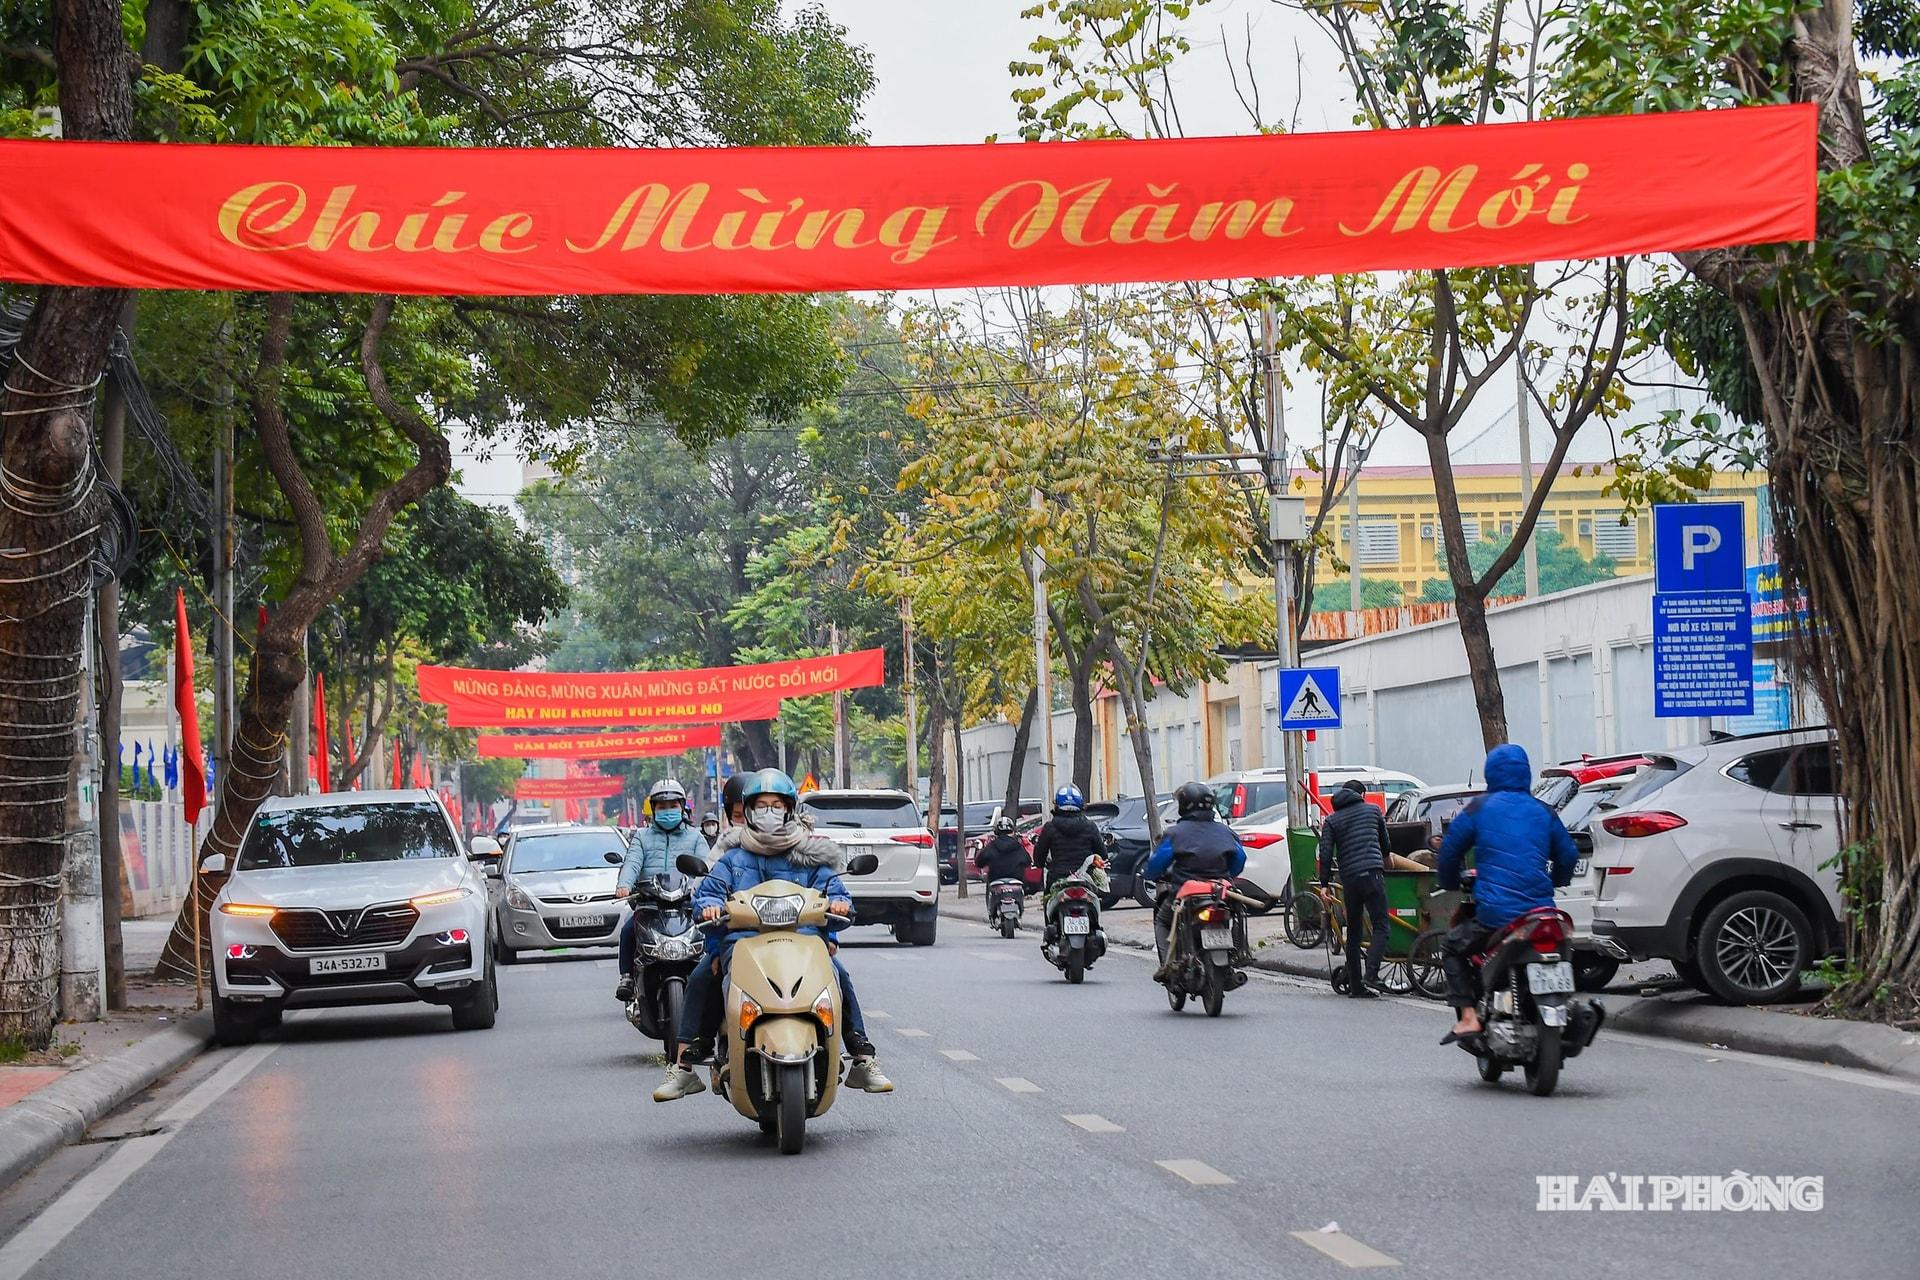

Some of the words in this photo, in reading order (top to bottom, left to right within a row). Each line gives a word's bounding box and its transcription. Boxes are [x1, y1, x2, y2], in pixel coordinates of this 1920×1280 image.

[217, 181, 538, 253] Chúc
[565, 182, 958, 264] Mừng
[976, 178, 1298, 249] Năm
[1338, 162, 1590, 236] Mới
[1682, 525, 1721, 570] P
[1691, 623, 1700, 632] XE
[1711, 622, 1724, 631] THU
[453, 677, 499, 696] MỪNG
[697, 675, 728, 694] ĐẤT
[732, 674, 775, 692] NƯỚC
[780, 666, 806, 687] ĐỔI
[810, 668, 838, 684] MỚI
[316, 956, 380, 972] 34A-532.73
